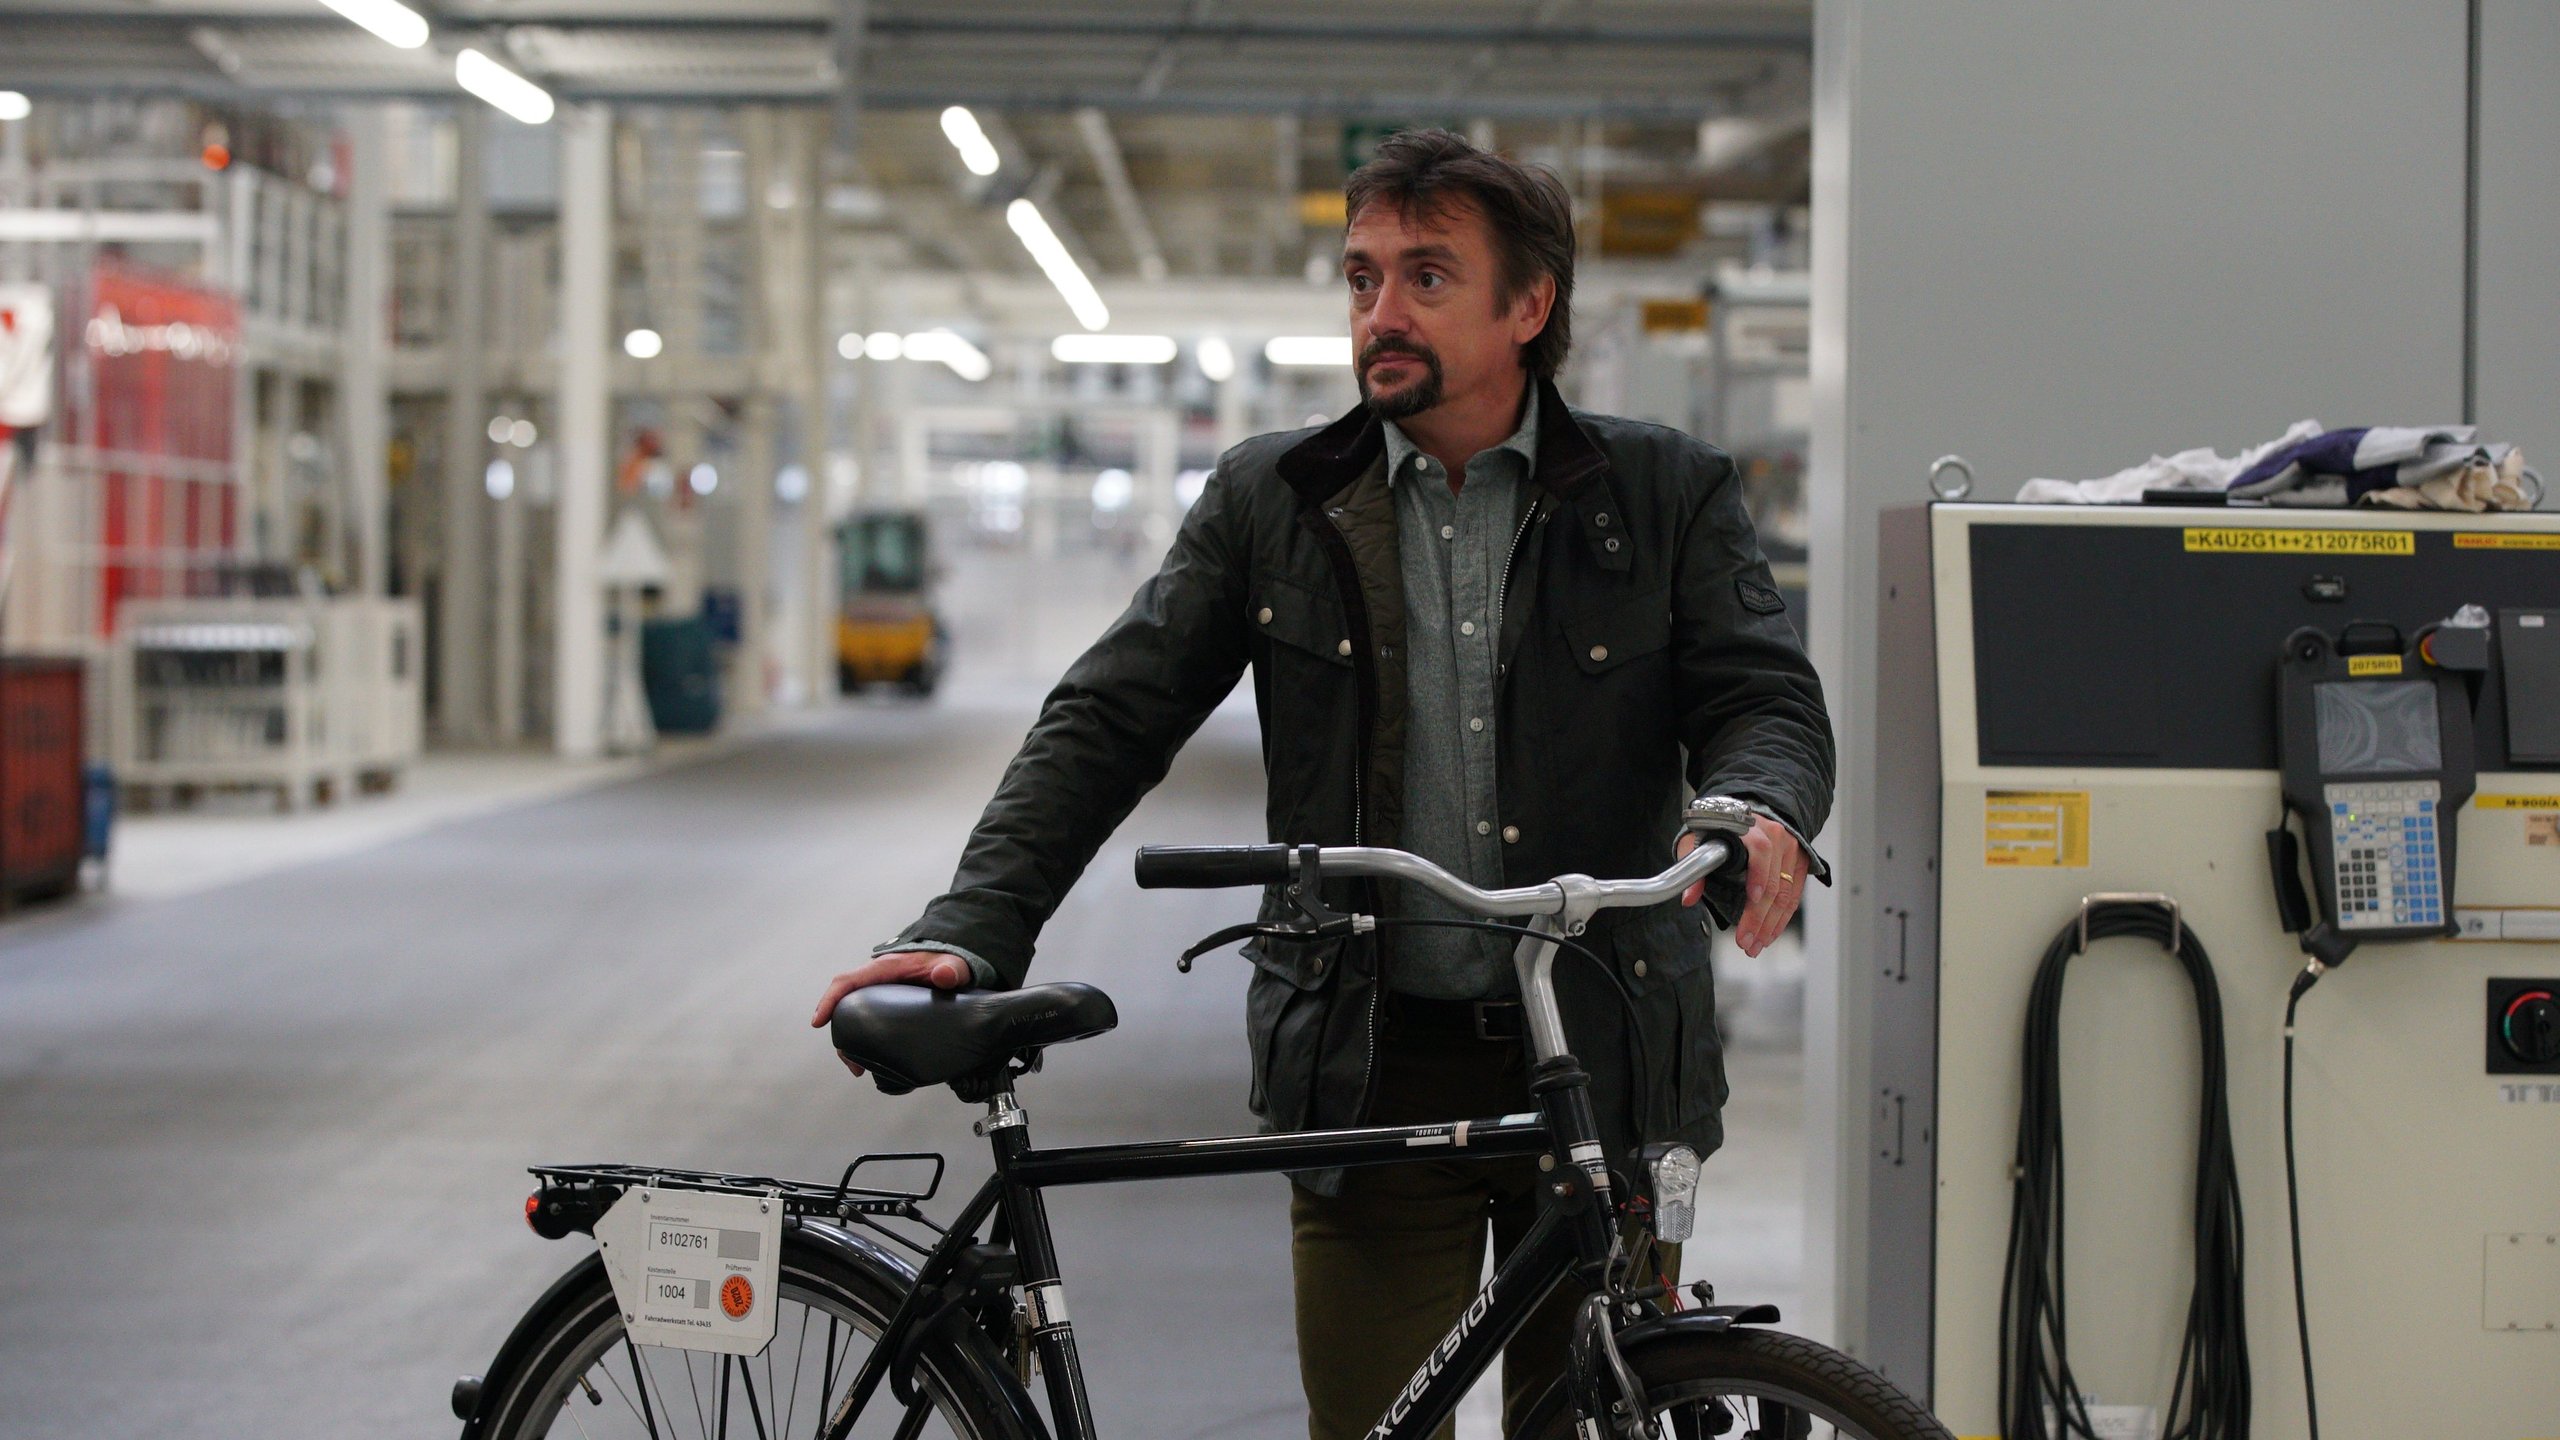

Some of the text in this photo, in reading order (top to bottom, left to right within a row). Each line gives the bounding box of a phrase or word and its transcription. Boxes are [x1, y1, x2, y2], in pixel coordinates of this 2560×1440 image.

[1415, 1127, 1443, 1137] TOURING
[660, 1231, 709, 1250] 8102761
[647, 1266, 677, 1275] Kostenstelle
[725, 1263, 752, 1273] Prüftermin
[658, 1284, 686, 1300] 1004
[644, 1314, 687, 1326] Fahrradwerkstatt
[687, 1319, 696, 1327] Tel.
